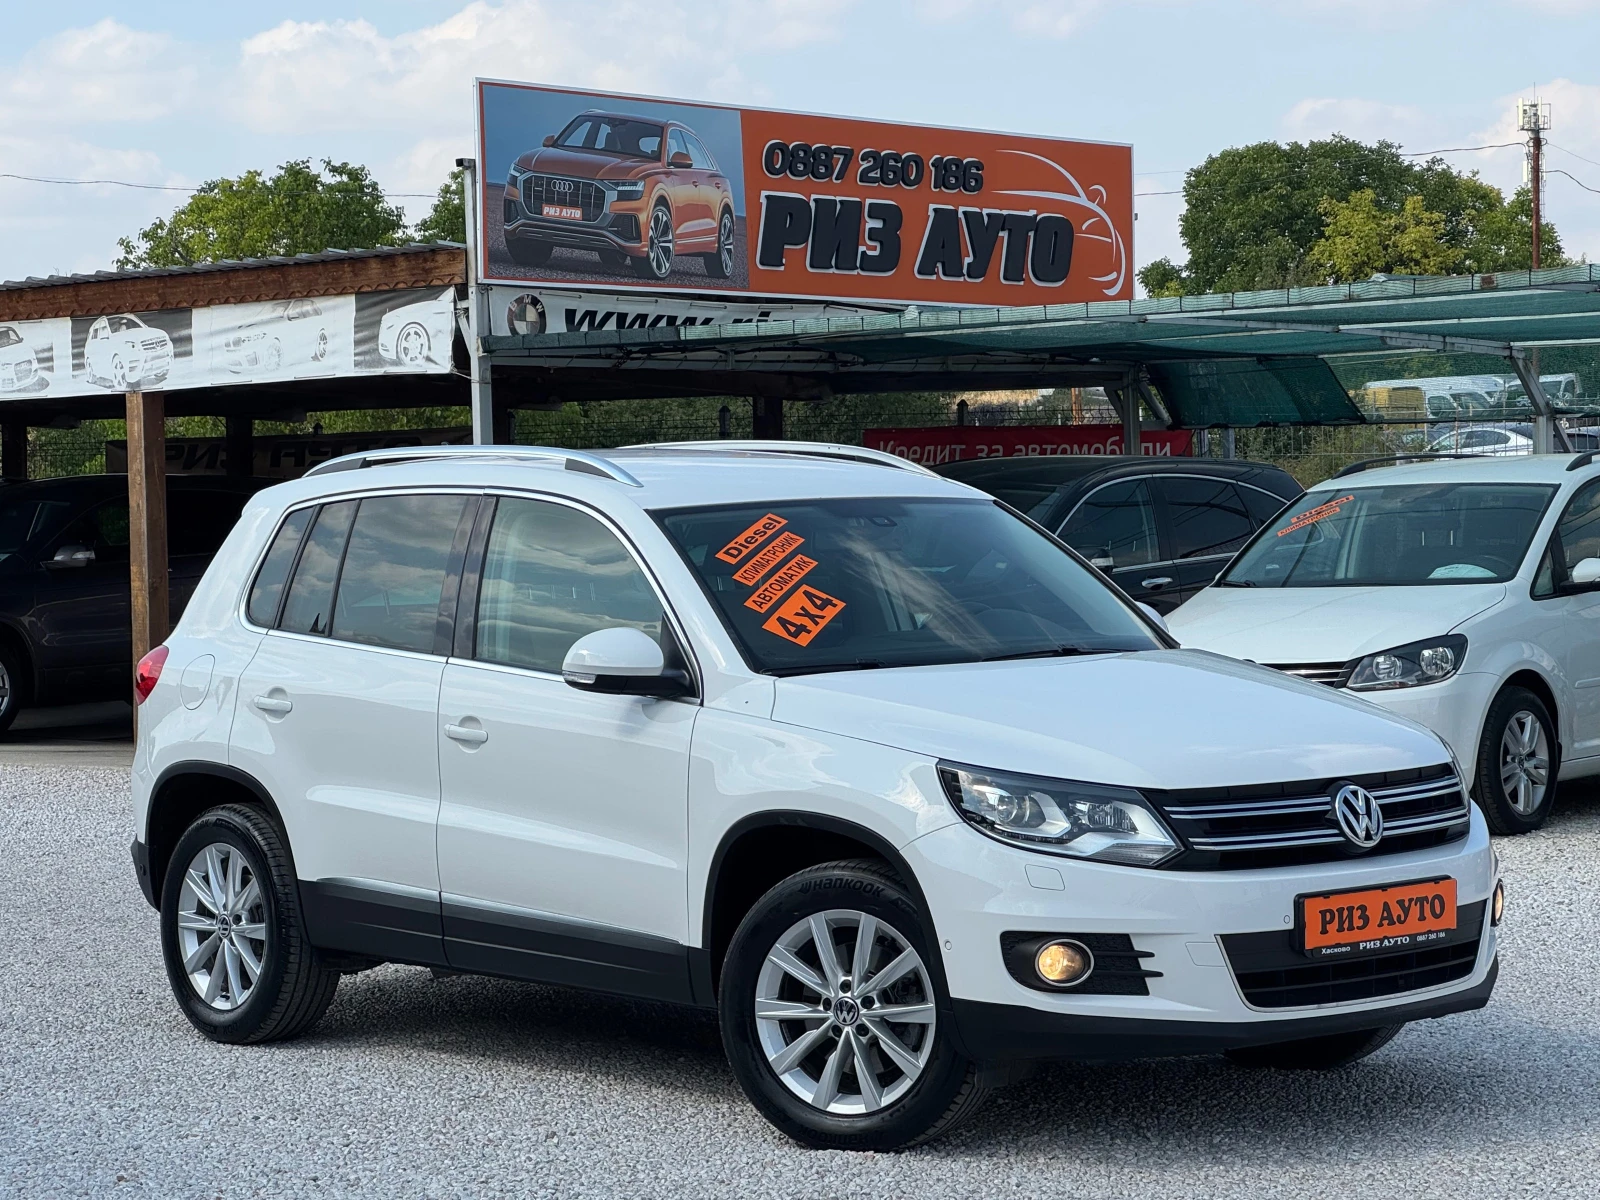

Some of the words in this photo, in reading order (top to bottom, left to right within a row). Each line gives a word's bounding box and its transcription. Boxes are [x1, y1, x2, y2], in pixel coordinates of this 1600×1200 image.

[762, 139, 854, 184] 0887
[857, 148, 925, 189] 260
[930, 154, 985, 194] 186
[543, 206, 560, 216] РИЗ
[561, 208, 581, 218] АУТО
[756, 191, 903, 276] РИЗ
[914, 204, 1075, 287] АУТО
[975, 445, 1004, 458] за
[1014, 436, 1171, 457] автомобли
[722, 516, 782, 559] Diesel
[738, 532, 800, 582] КЛИМАТРОНИК
[752, 556, 814, 609] АВТОМАТИК
[1319, 904, 1370, 935] РИЗ
[1377, 893, 1446, 928] АУТО
[1321, 946, 1351, 955] Хасково
[1359, 940, 1381, 950] РИЗ
[1382, 936, 1410, 947] АУТО
